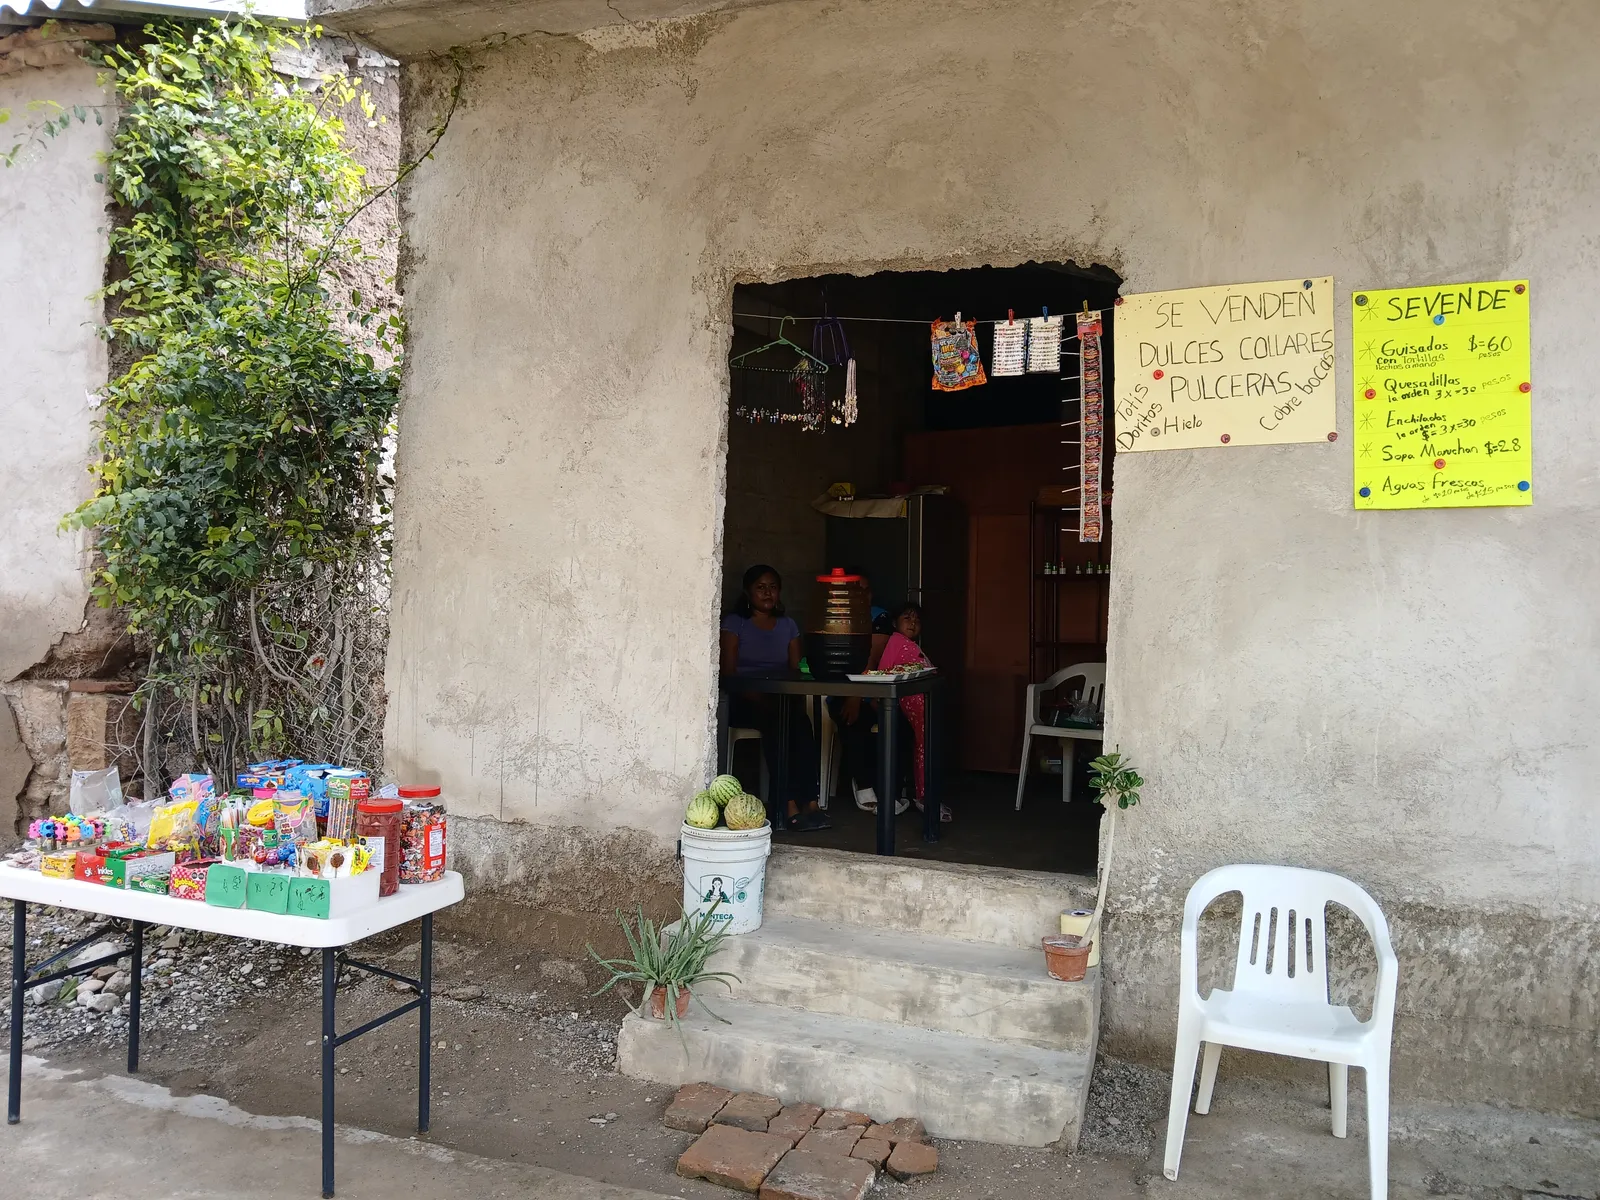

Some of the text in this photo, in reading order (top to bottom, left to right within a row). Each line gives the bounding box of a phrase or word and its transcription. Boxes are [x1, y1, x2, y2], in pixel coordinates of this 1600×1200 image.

[1155, 291, 1316, 329] SE VENDEN
[1139, 329, 1334, 368] DULCES COLLARES
[1381, 335, 1449, 357] Guisados
[1478, 350, 1501, 360] pesos
[1402, 353, 1445, 364] Tortillas
[1412, 361, 1437, 369] mano
[1170, 371, 1292, 402] PULCERAS
[1259, 350, 1334, 431] Cobre bocas
[1383, 372, 1461, 394] Quesadillas
[1401, 388, 1430, 400] orden
[1482, 373, 1512, 390] pesos
[1114, 383, 1149, 422] Totis
[1116, 401, 1163, 450] Doritos
[1164, 414, 1203, 435] Hielo
[1386, 410, 1447, 428] Enchiladas
[1409, 423, 1437, 436] orden
[1382, 445, 1415, 462] Sopa
[1382, 475, 1426, 496] Aguas
[699, 912, 735, 920] MNTECA
